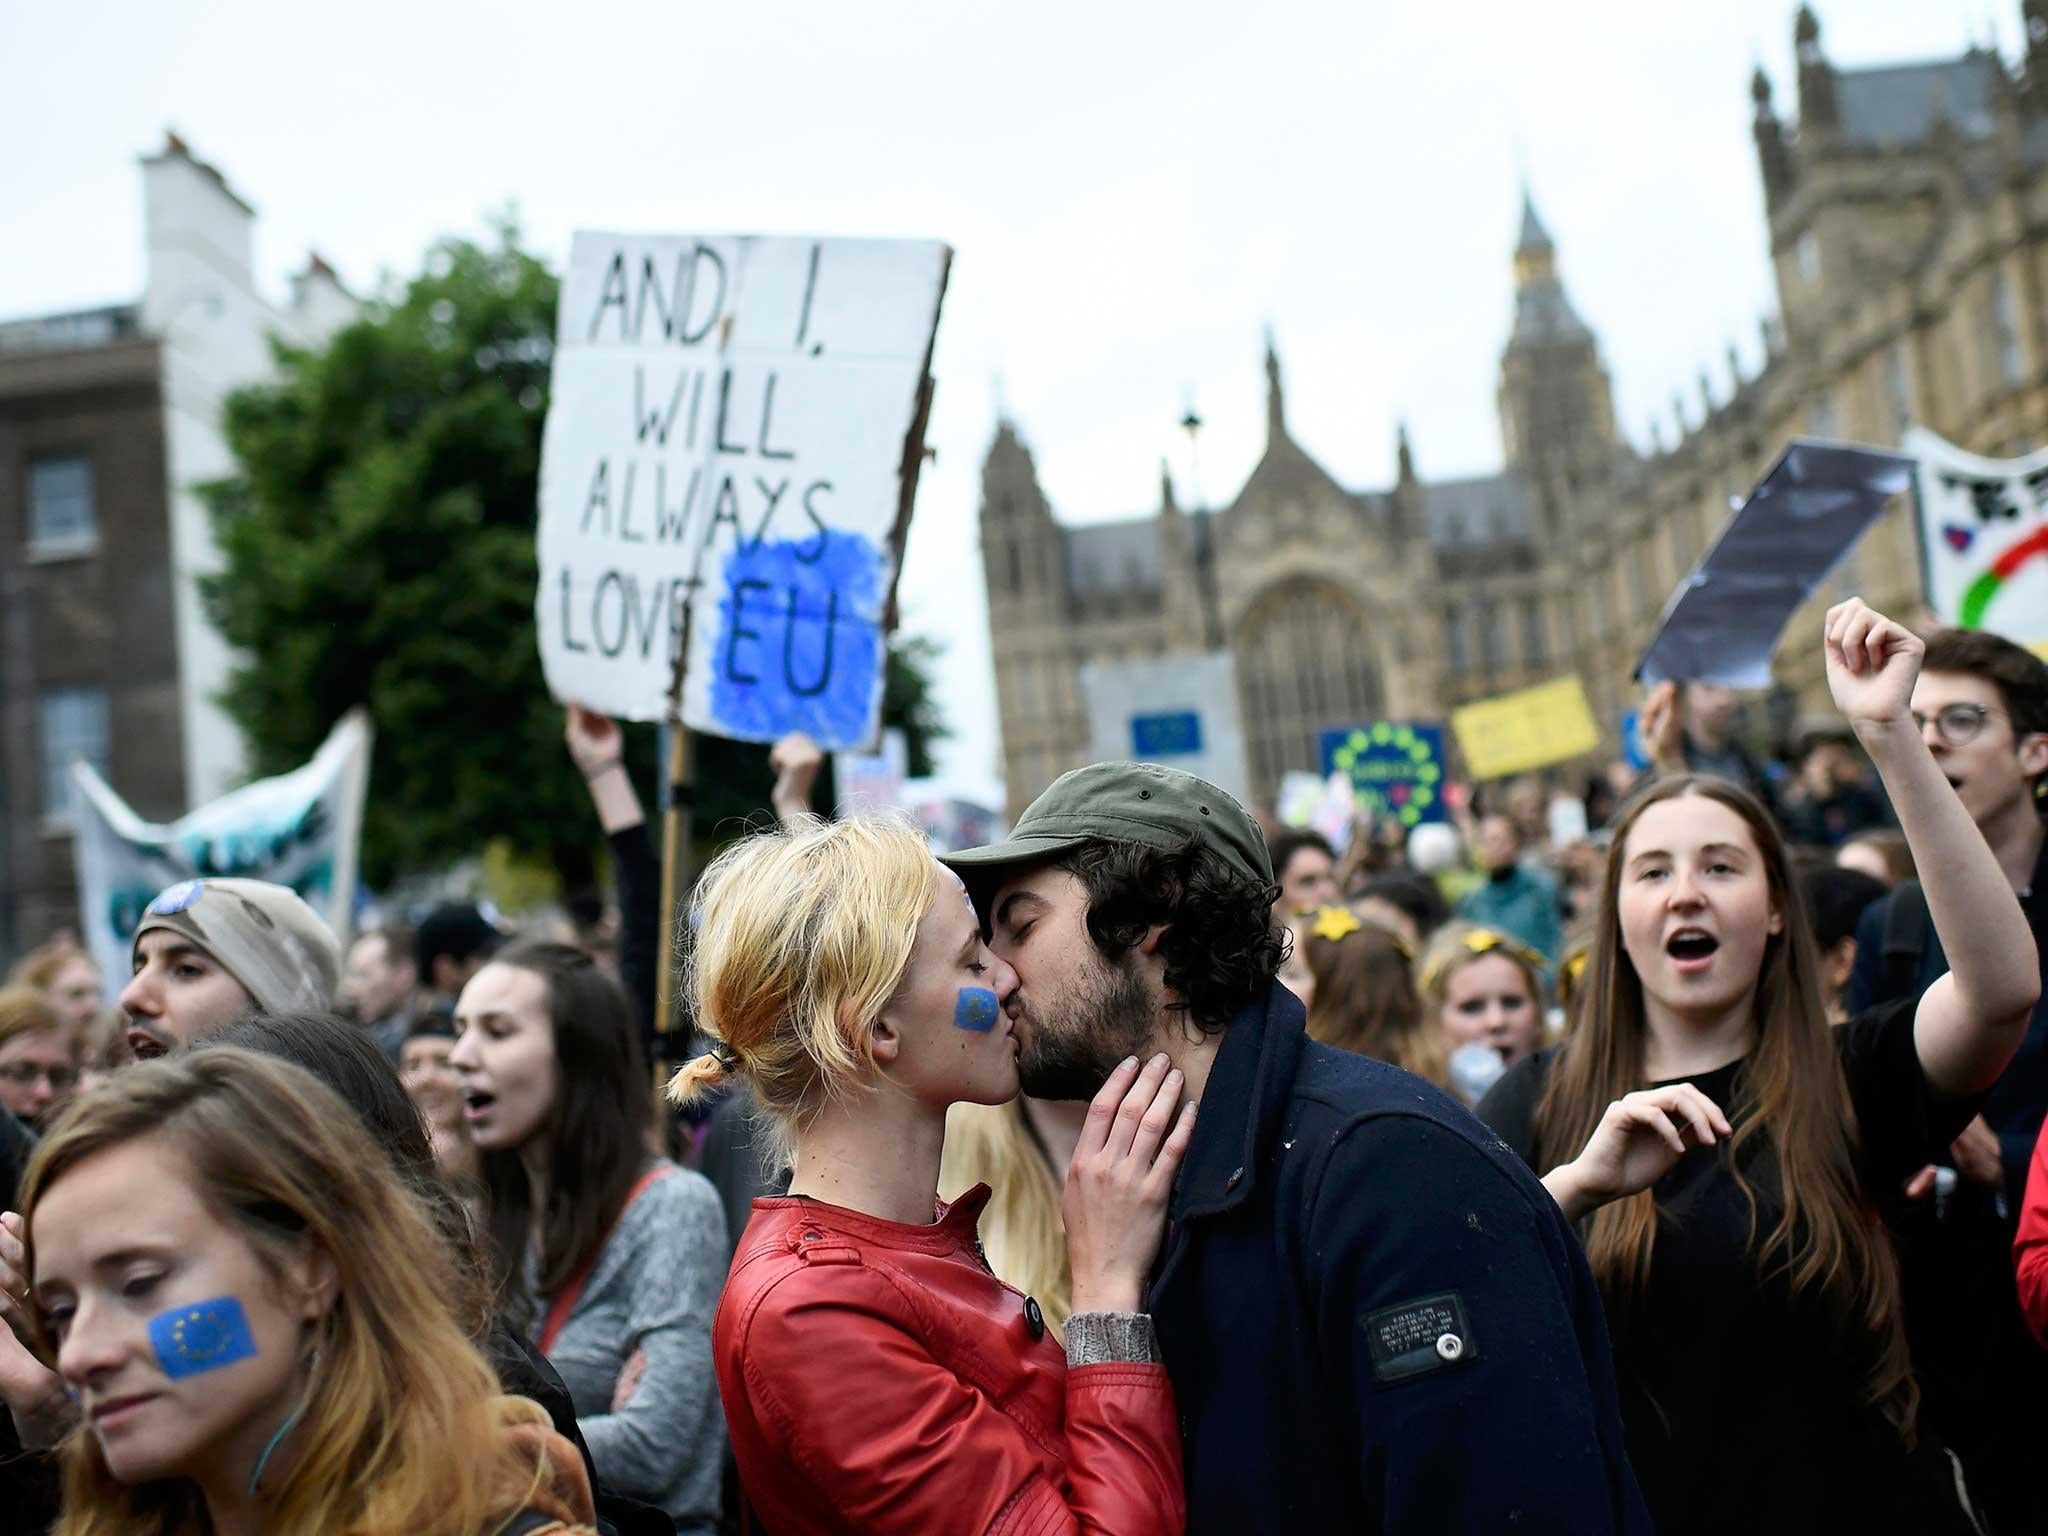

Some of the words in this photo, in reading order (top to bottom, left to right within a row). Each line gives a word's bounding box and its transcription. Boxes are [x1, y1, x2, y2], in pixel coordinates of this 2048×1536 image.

[634, 367, 796, 460] WILL
[581, 456, 834, 565] ALWAYS
[726, 579, 838, 697] EU
